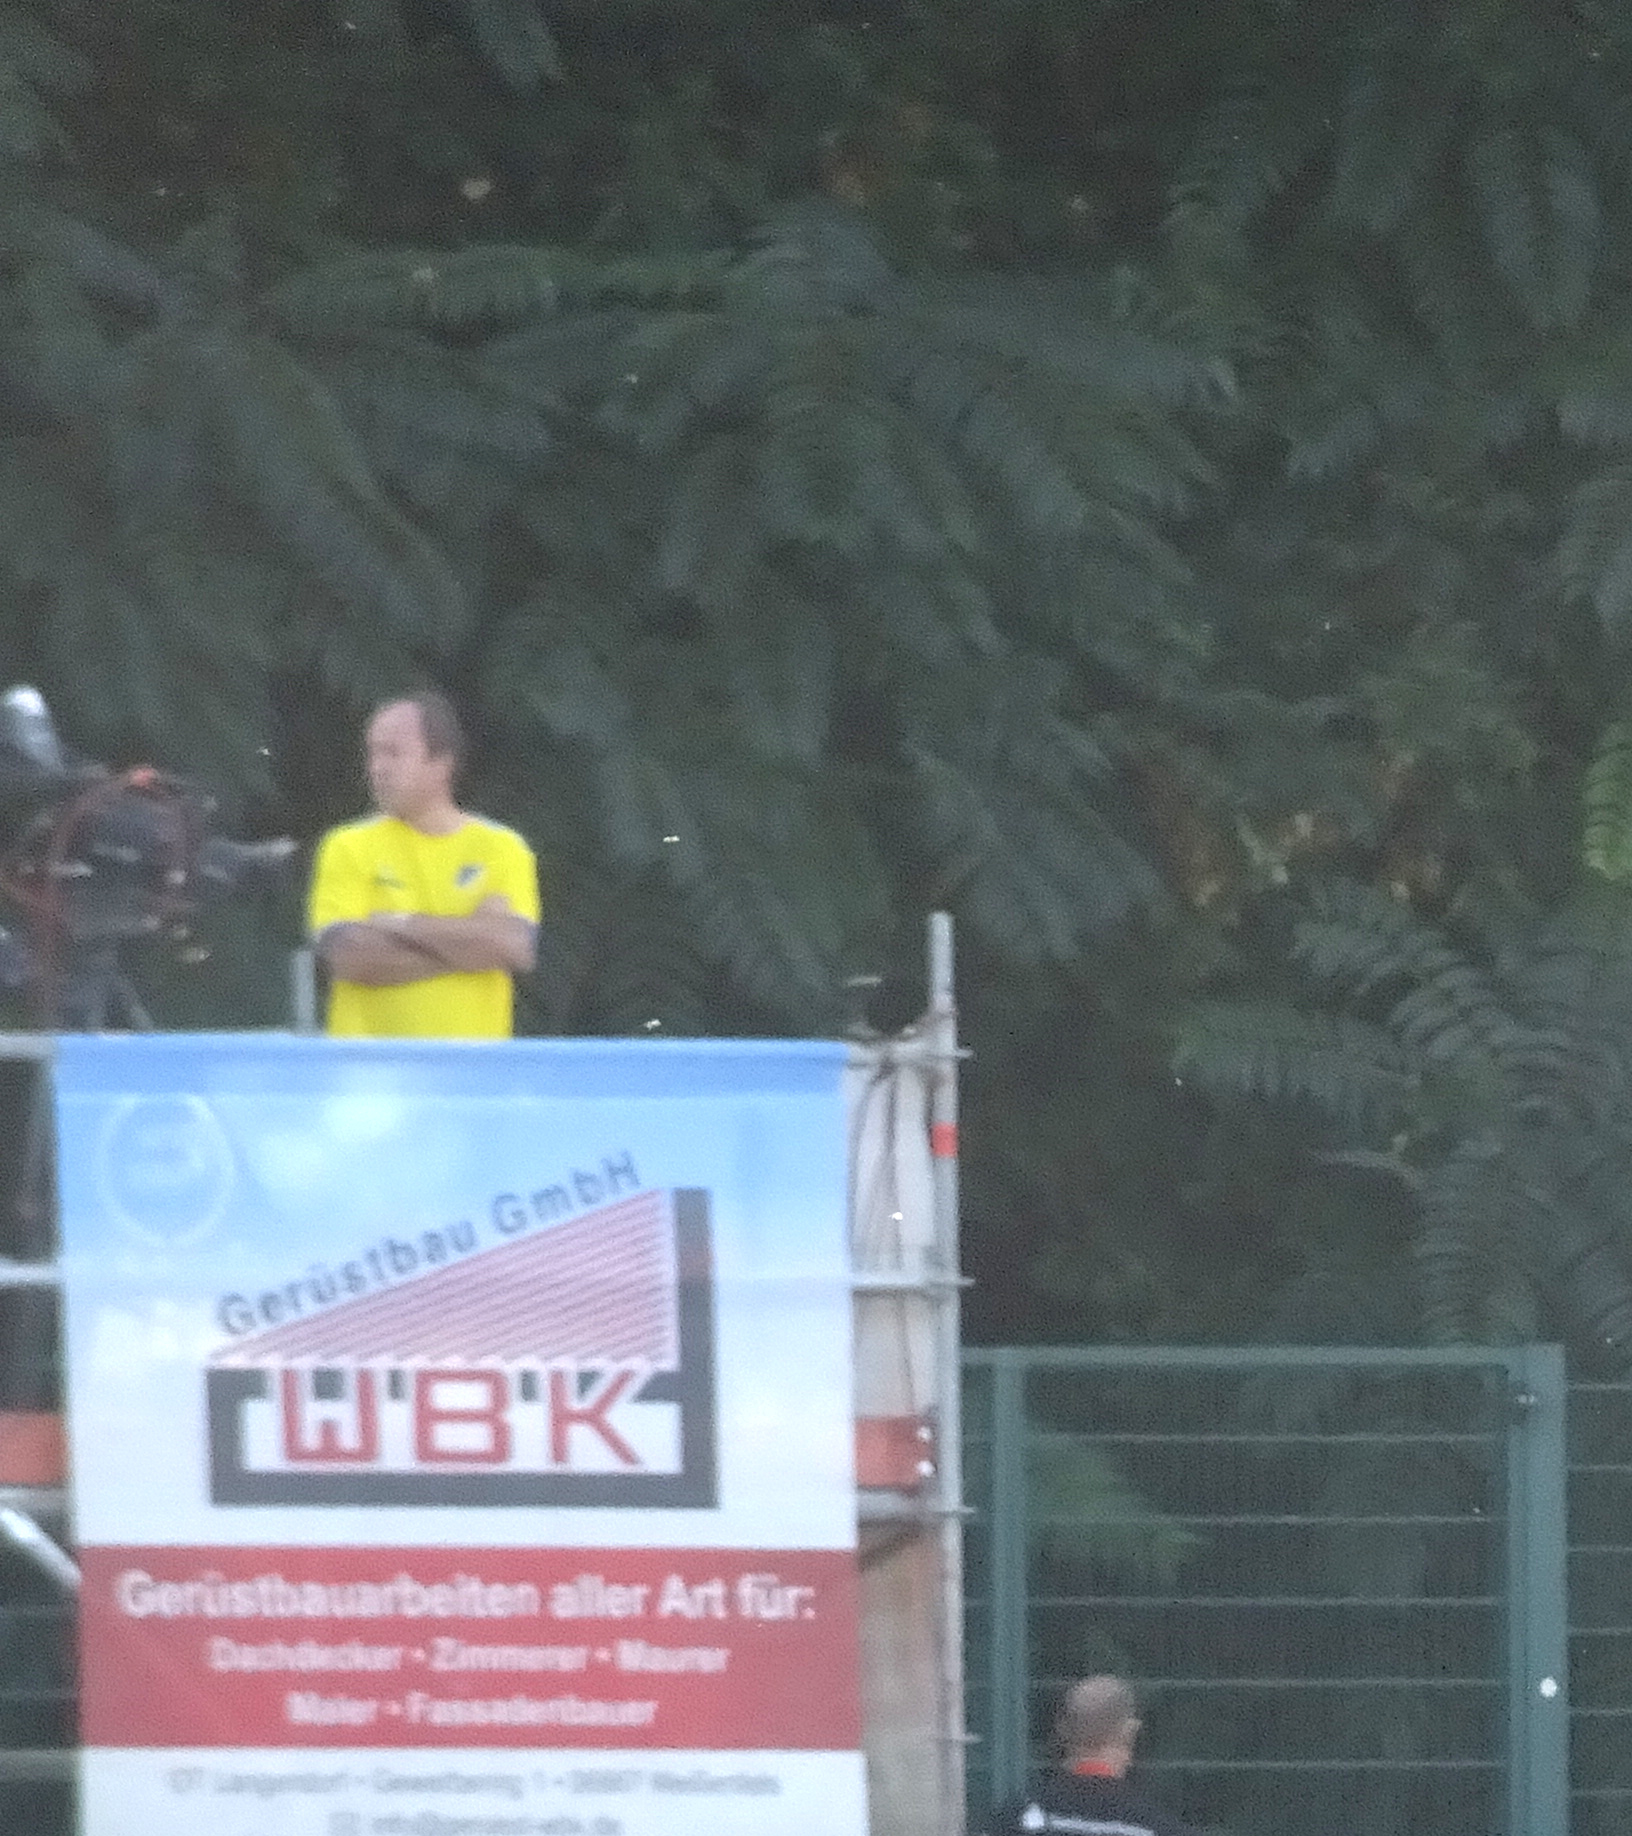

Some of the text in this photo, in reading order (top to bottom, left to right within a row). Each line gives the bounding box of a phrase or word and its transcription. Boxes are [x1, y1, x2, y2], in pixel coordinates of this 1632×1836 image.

[216, 1150, 643, 1337] Gerüstbau GmbH
[279, 1366, 648, 1466] WBK
[115, 1568, 816, 1621] Gerüstbauarbeiten aller Art für:
